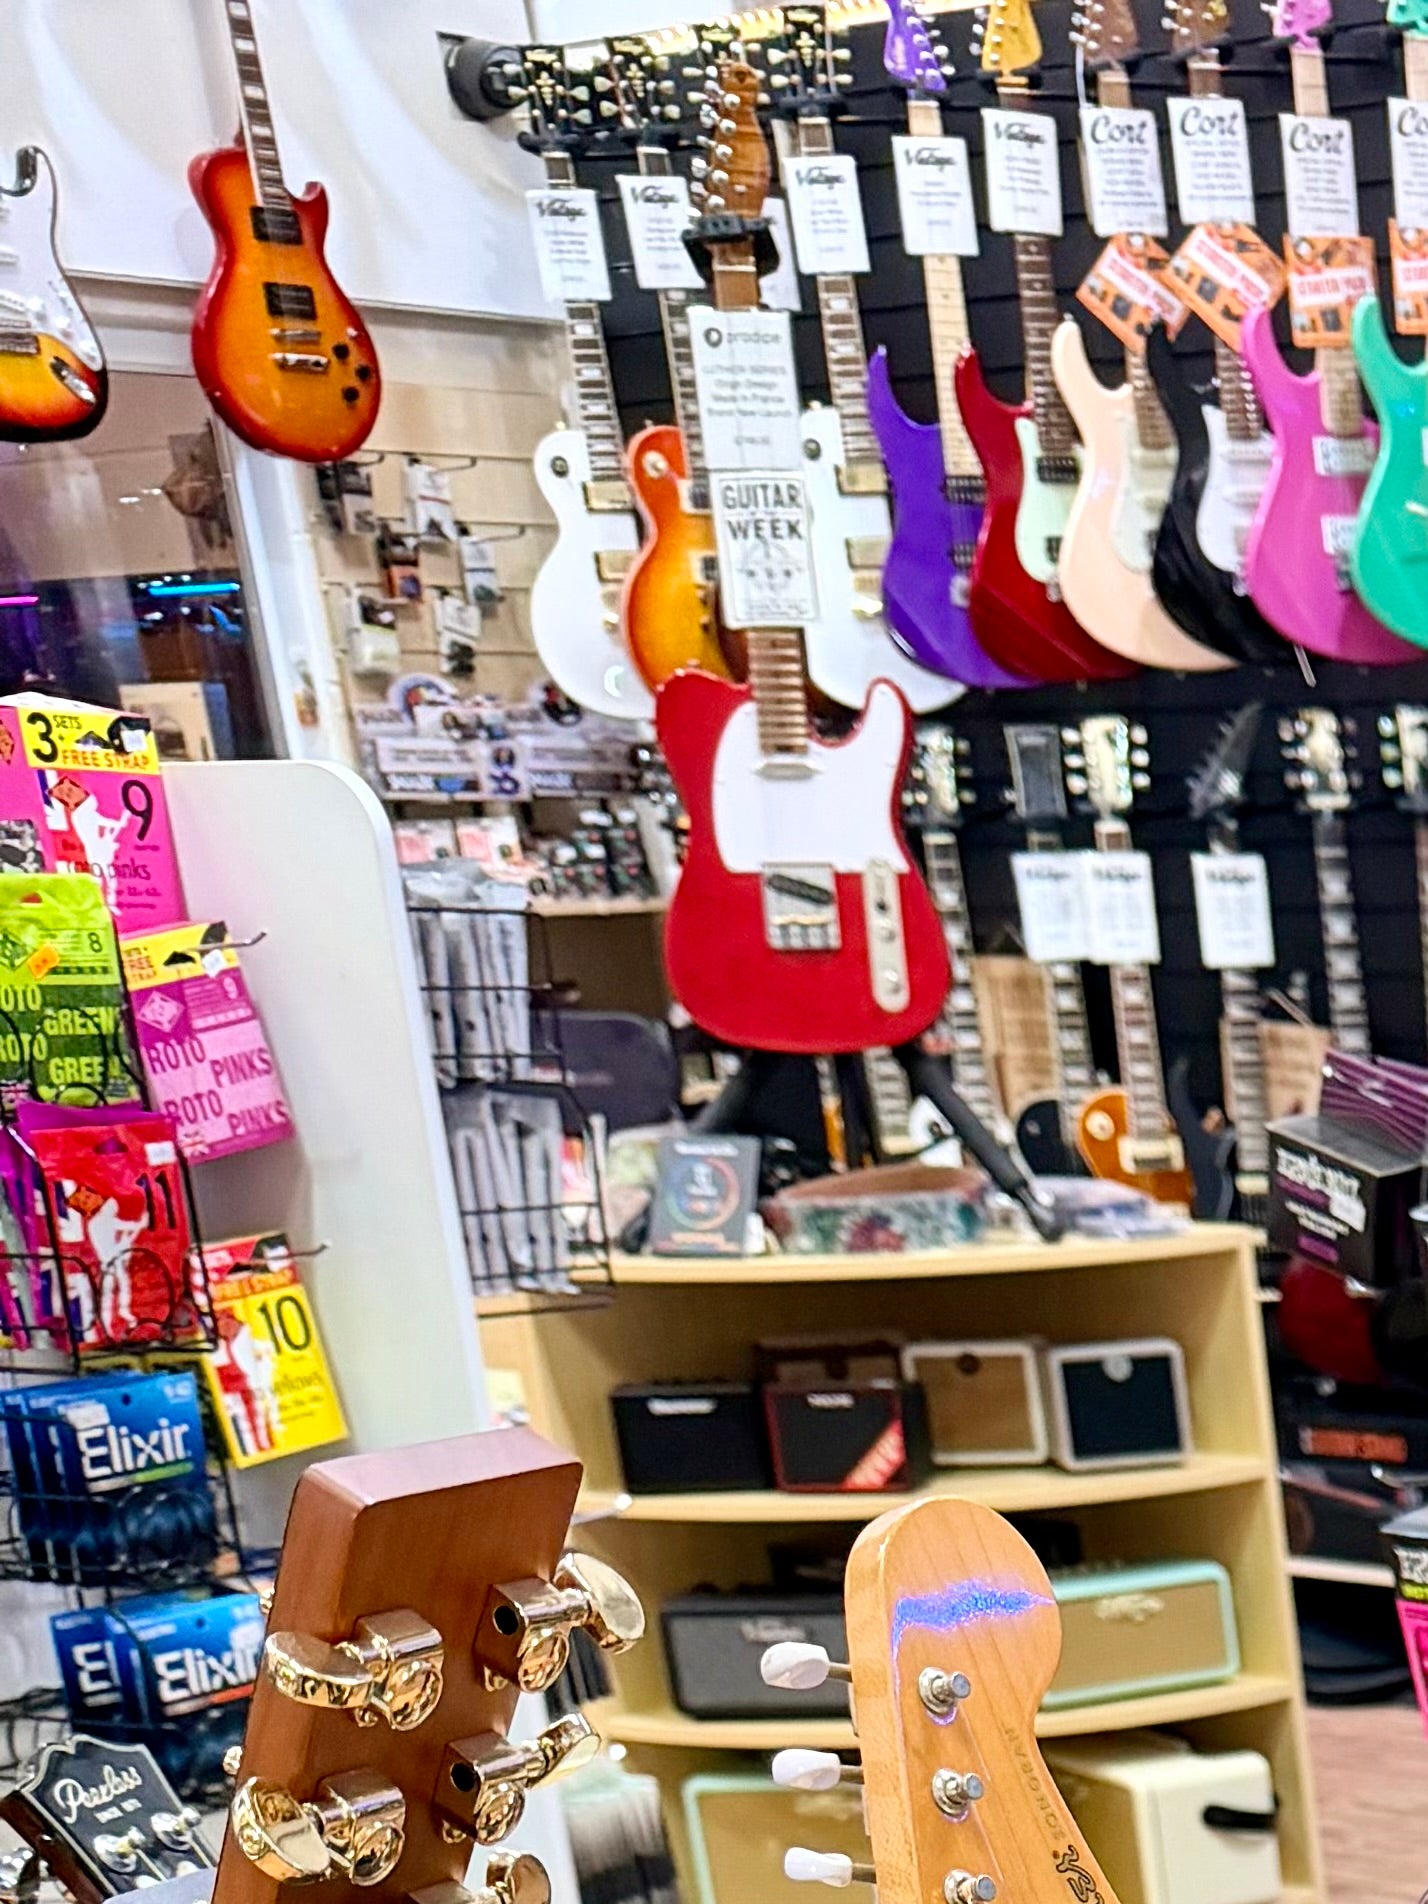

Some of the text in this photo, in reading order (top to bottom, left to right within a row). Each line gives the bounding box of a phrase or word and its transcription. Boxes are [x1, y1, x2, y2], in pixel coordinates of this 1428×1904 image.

[1090, 117, 1148, 145] Cort
[1180, 107, 1239, 137] Cort
[1289, 123, 1346, 154] Cort
[721, 483, 801, 511] GUITAR
[727, 518, 803, 541] WEEK
[27, 711, 59, 763] 3
[62, 749, 101, 768] FREE
[121, 779, 154, 841] 9
[87, 932, 104, 953] 8
[148, 1037, 208, 1076] ROTO
[209, 1047, 275, 1089] PINKS
[227, 1100, 290, 1138] PINKS
[136, 1169, 176, 1232] 11
[259, 1295, 314, 1357] 10
[76, 1417, 190, 1480] Elixir
